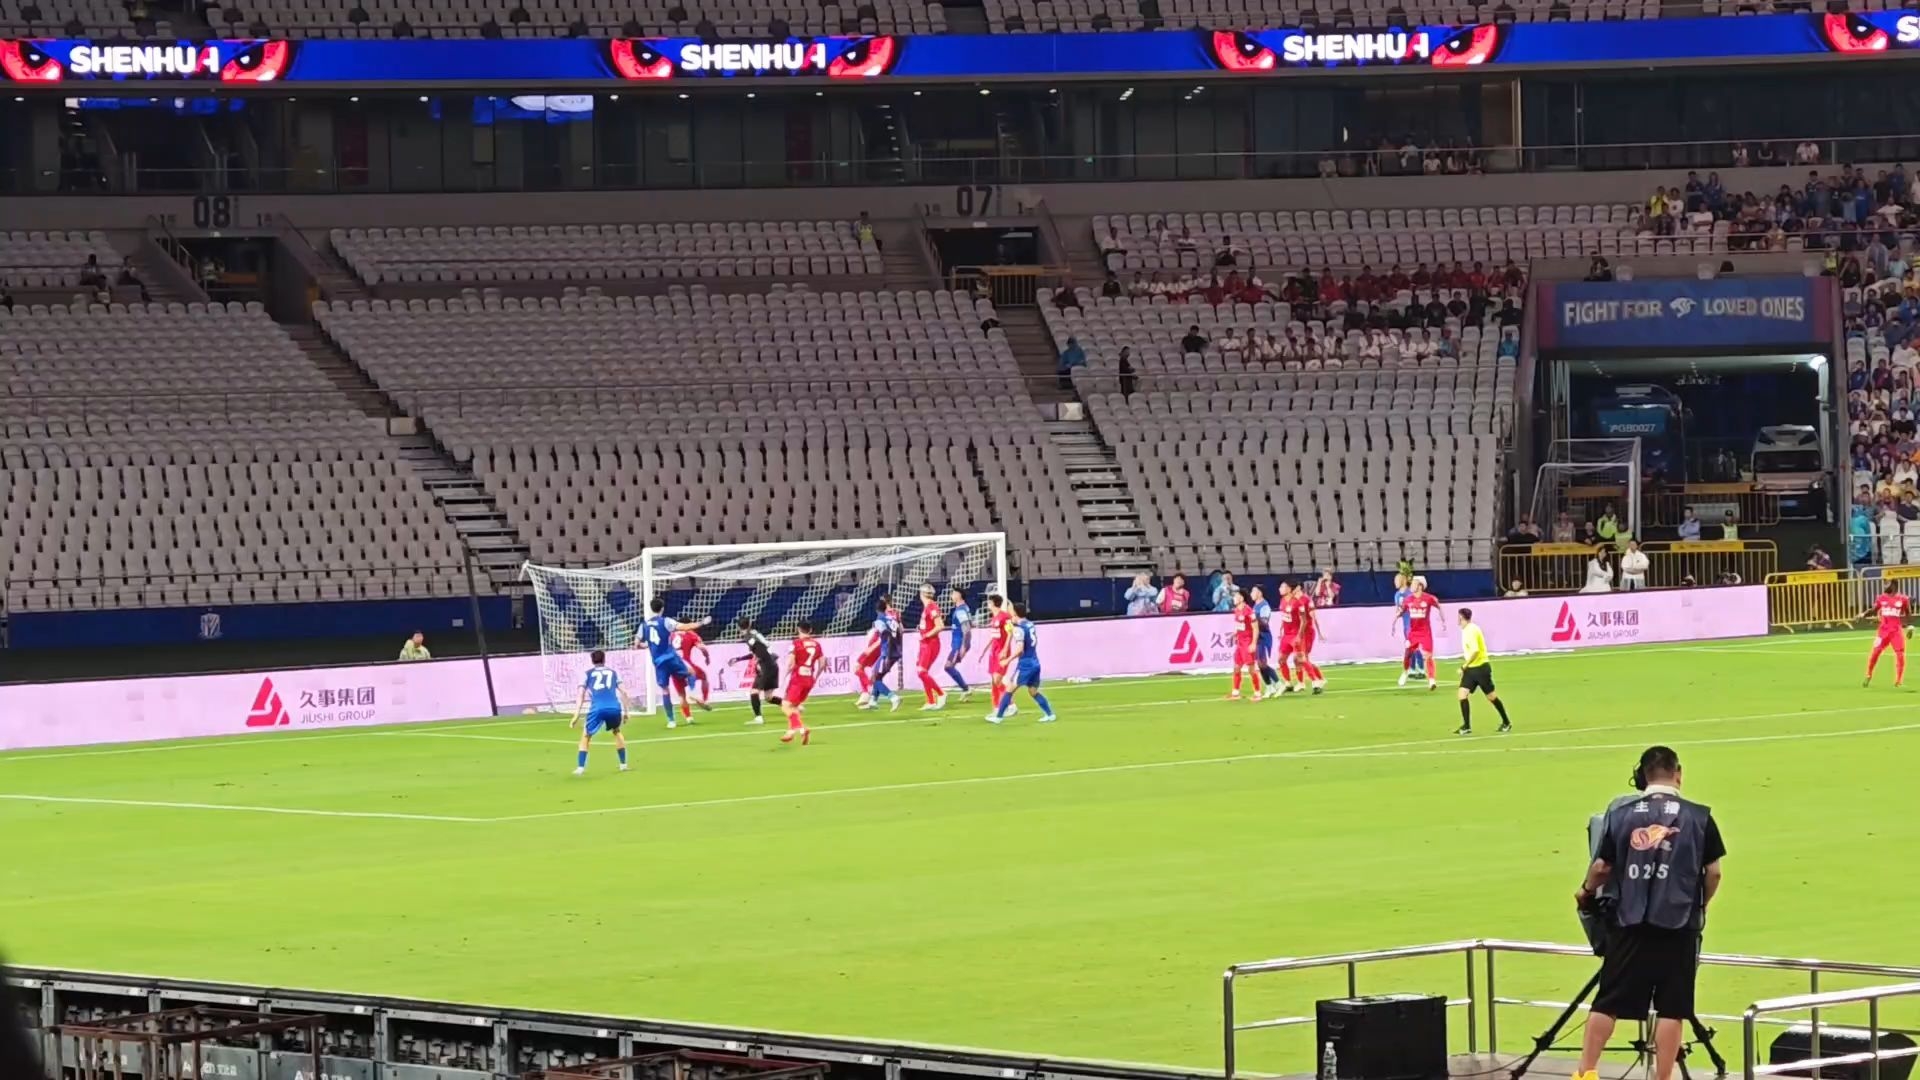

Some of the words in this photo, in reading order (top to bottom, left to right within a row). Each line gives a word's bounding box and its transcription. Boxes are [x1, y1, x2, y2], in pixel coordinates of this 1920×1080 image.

[1896, 15, 1920, 42] S
[69, 45, 220, 73] SHENHUA
[680, 43, 826, 70] SHENHUA
[1283, 33, 1429, 61] SHENHUA
[193, 196, 231, 229] 08
[957, 185, 993, 216] 07
[1564, 301, 1619, 327] FIGHT
[1622, 300, 1663, 319] FOR
[1703, 298, 1756, 316] LOVED
[1760, 297, 1805, 321] ONES
[1587, 610, 1639, 628] 久事集团
[1613, 628, 1639, 639] GROUP
[805, 646, 816, 667] 7
[591, 670, 614, 691] 27
[300, 687, 375, 708] 久事集团
[301, 711, 334, 724] JIUSHI
[338, 709, 376, 722] GROUP
